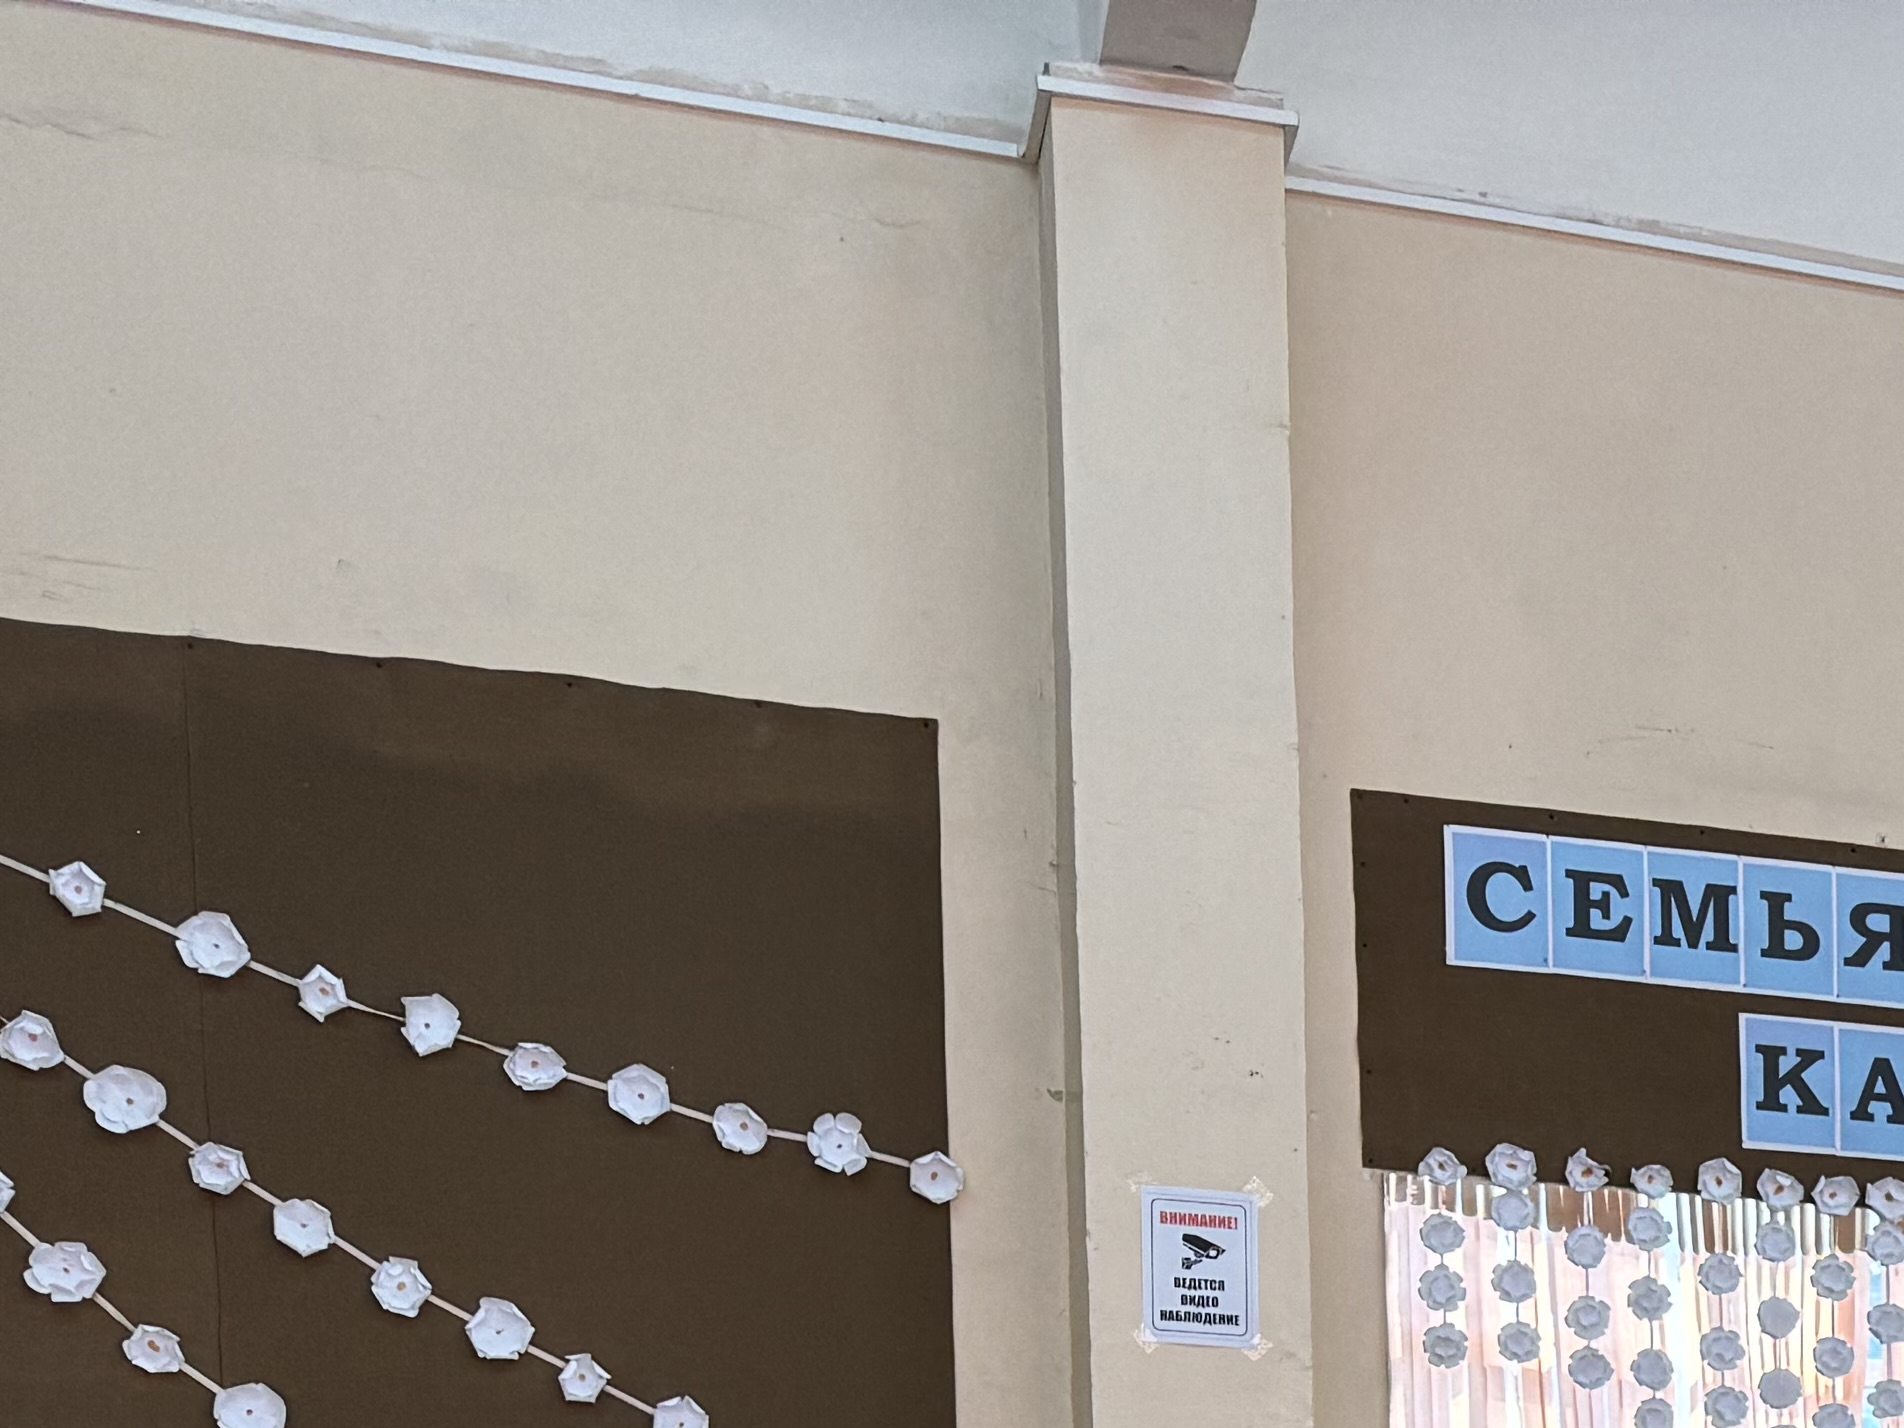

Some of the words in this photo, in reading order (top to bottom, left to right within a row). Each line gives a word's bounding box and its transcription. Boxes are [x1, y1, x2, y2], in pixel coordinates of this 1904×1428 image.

[1159, 1210, 1239, 1230] ВНИМАНИЕ!
[1173, 1276, 1226, 1292] ВЕДЕТСЯ
[1180, 1294, 1220, 1309] ВИДЕО
[1159, 1309, 1240, 1327] НАБЛЮДЕНИЕ
